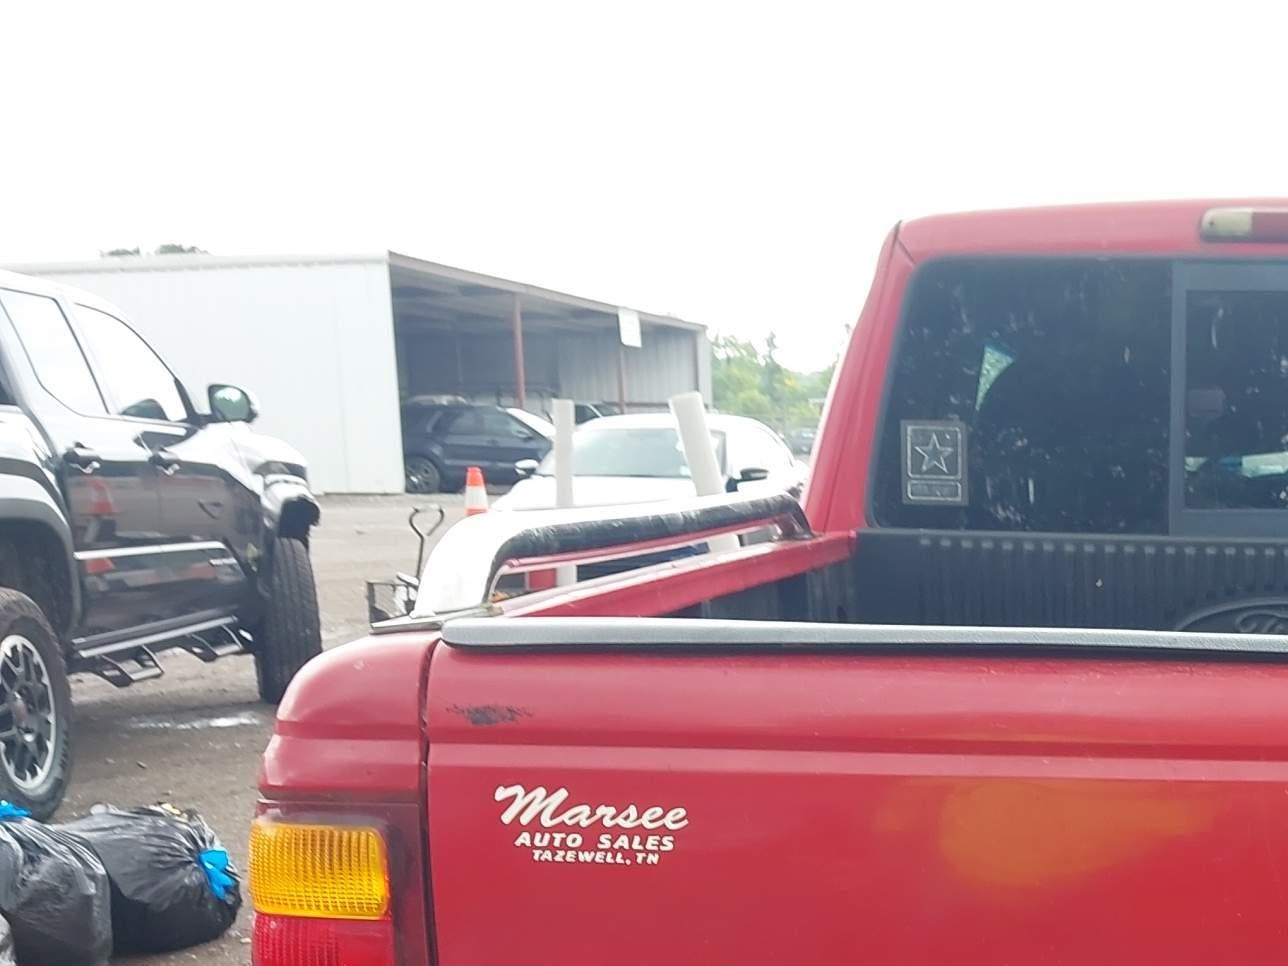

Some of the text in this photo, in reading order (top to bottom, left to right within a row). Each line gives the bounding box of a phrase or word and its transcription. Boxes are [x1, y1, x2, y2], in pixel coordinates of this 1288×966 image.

[494, 784, 688, 830] Marsee
[514, 832, 675, 851] AUTO SALES
[635, 852, 660, 865] TN
